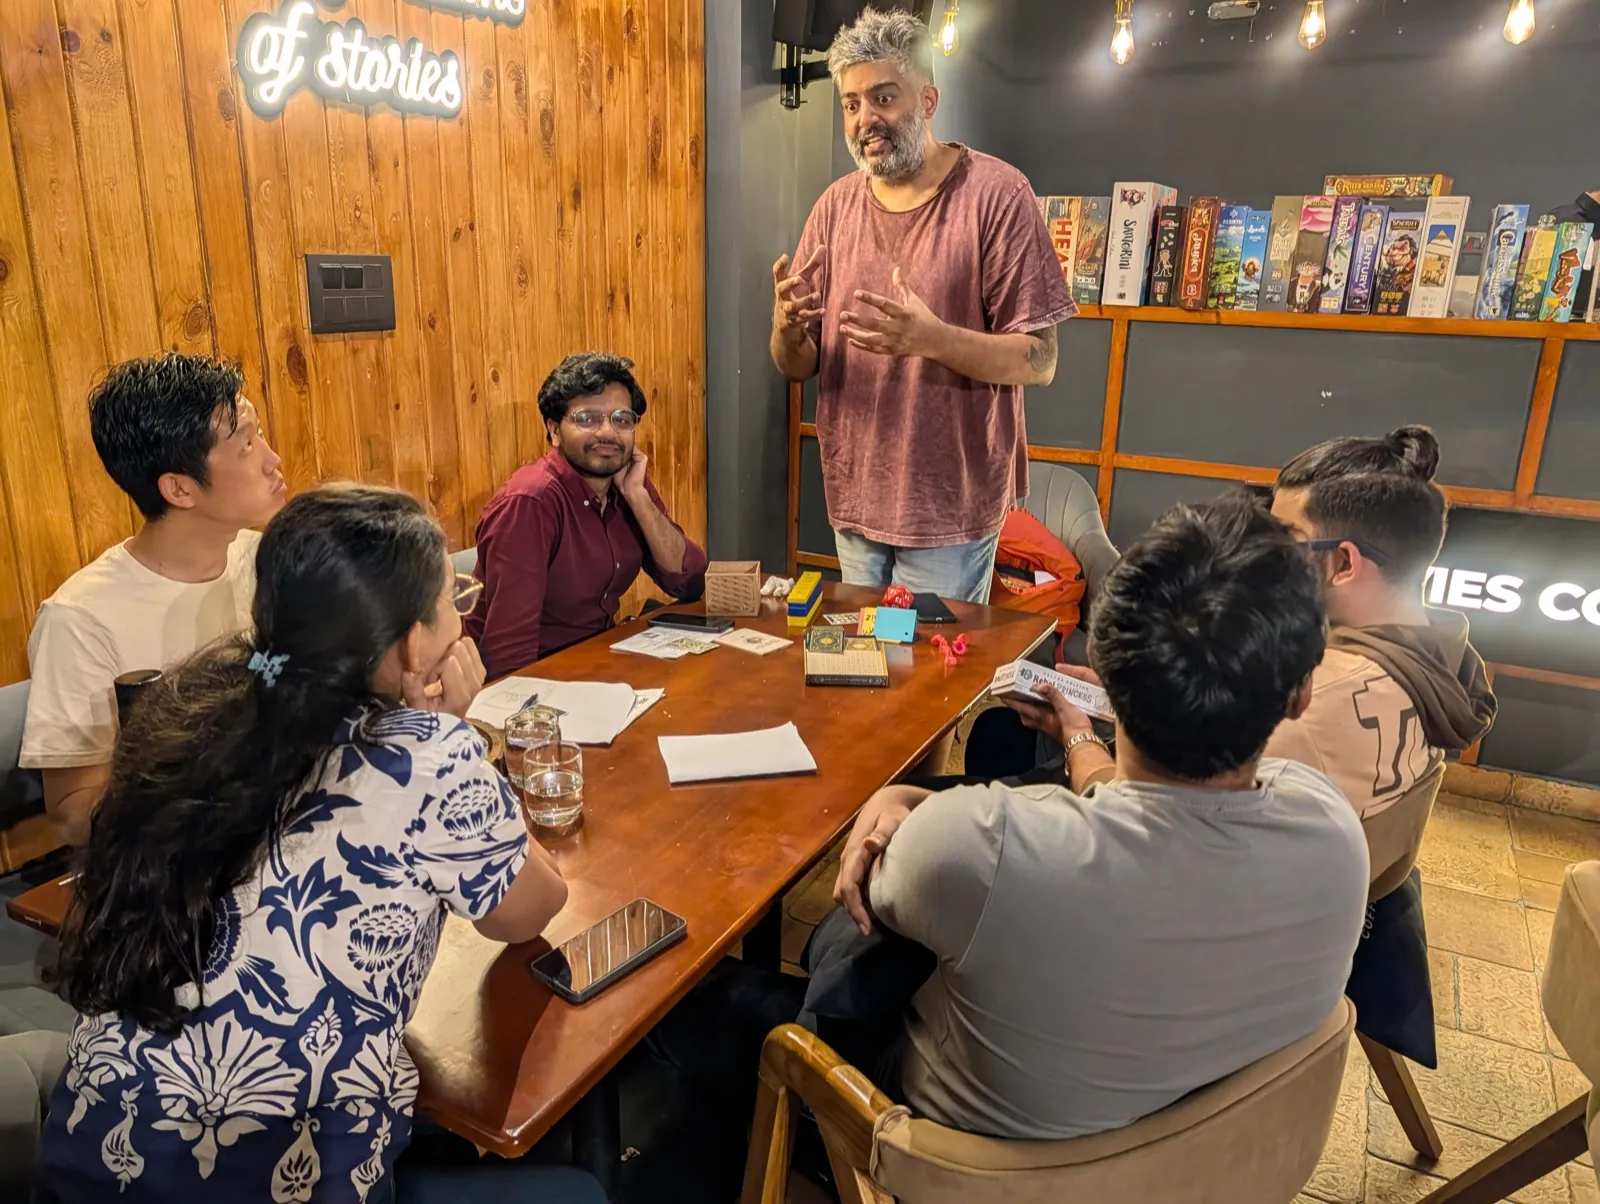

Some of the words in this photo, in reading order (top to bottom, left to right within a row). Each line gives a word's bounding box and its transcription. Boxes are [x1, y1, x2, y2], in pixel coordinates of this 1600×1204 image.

[249, 2, 315, 104] of
[316, 28, 461, 108] stories
[1358, 234, 1376, 288] CENTURY
[1056, 682, 1093, 704] PRINCESS
